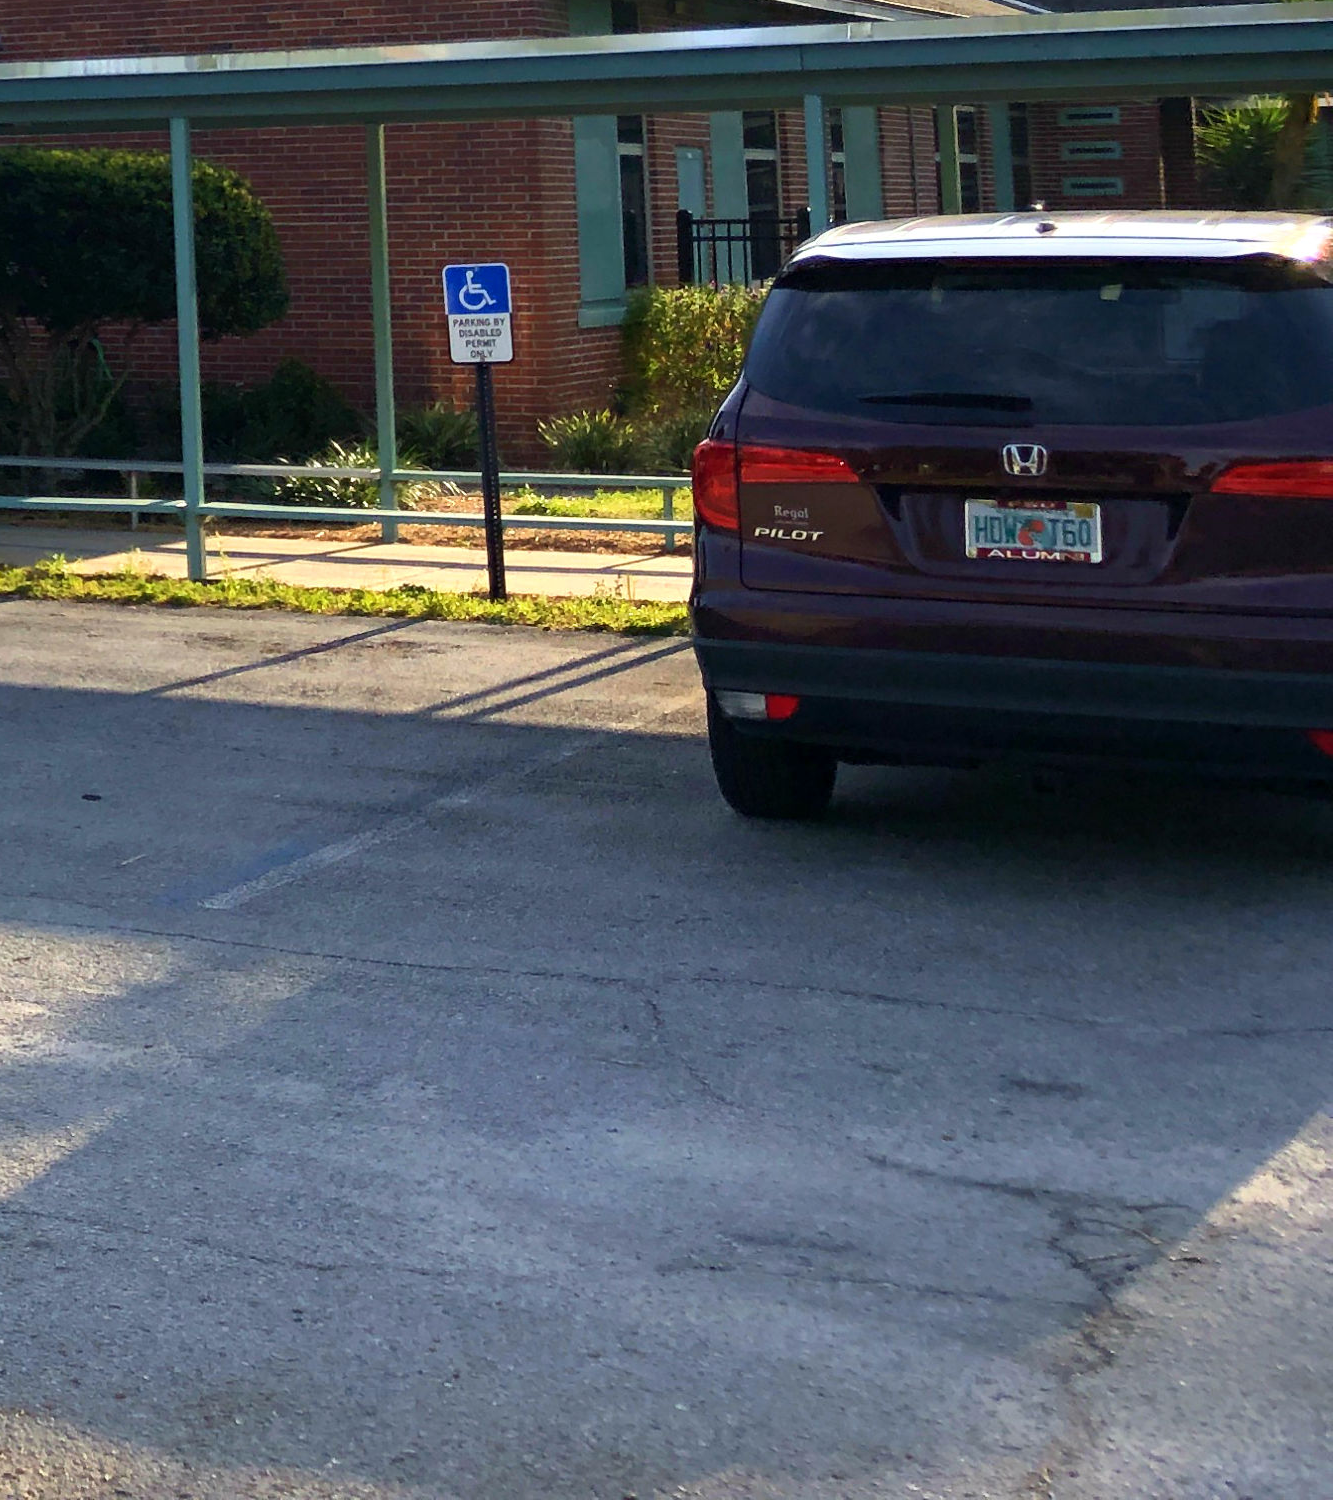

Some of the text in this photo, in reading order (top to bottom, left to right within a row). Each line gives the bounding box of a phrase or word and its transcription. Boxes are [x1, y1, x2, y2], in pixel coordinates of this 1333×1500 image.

[452, 317, 506, 328] PARKING BY
[458, 328, 502, 338] DISABLED
[465, 338, 497, 348] PERMIT
[470, 349, 494, 359] ONLY
[773, 505, 809, 520] Regal
[754, 526, 824, 542] PILOT
[987, 549, 1085, 561] ALUMNI
